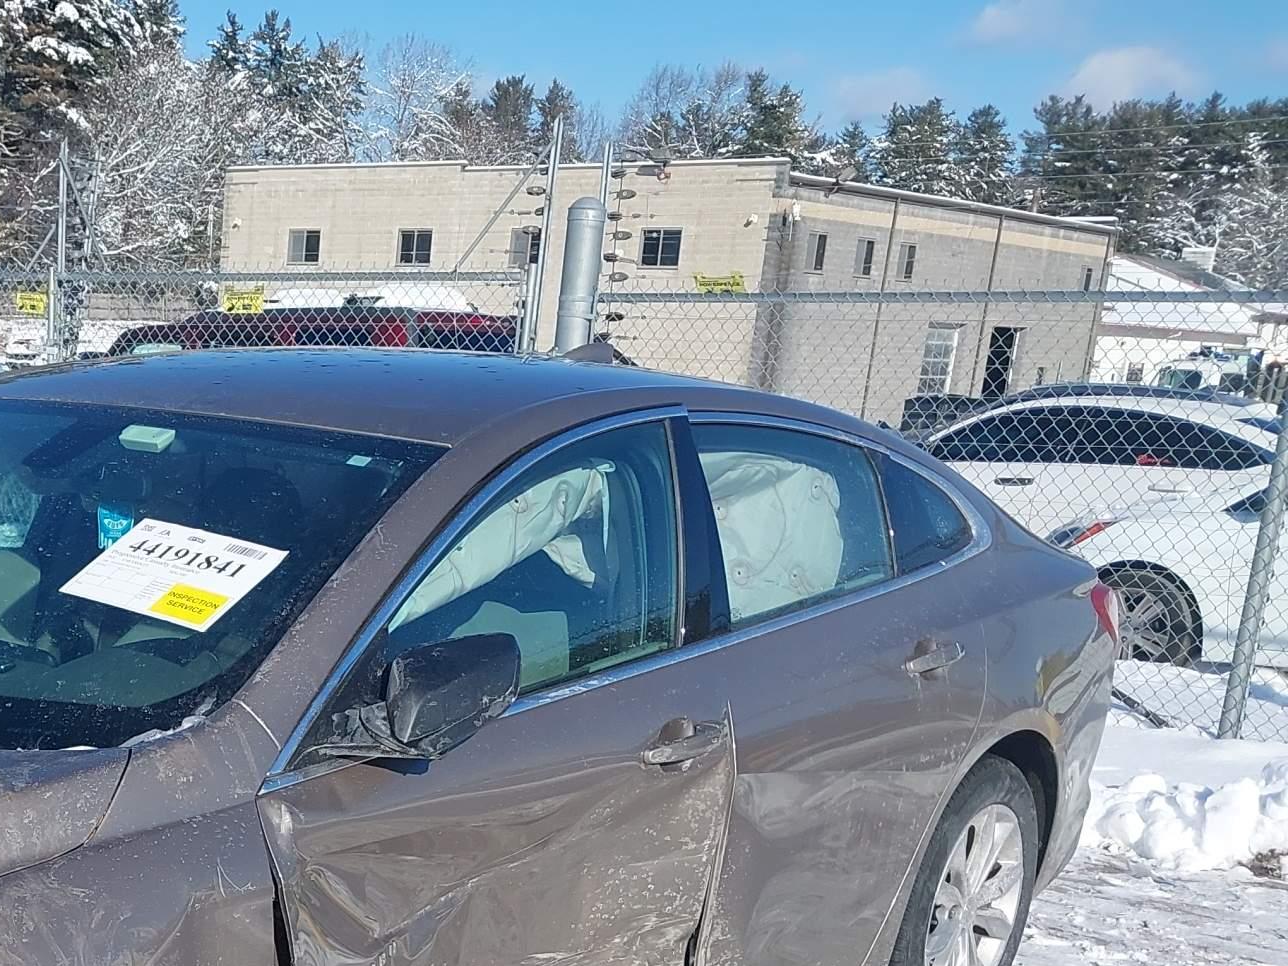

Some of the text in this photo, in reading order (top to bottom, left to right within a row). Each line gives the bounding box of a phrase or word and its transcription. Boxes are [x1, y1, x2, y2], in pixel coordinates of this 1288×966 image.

[129, 539, 246, 578] 44191841
[166, 599, 205, 615] SERVICE
[167, 591, 220, 610] INSPECTION
